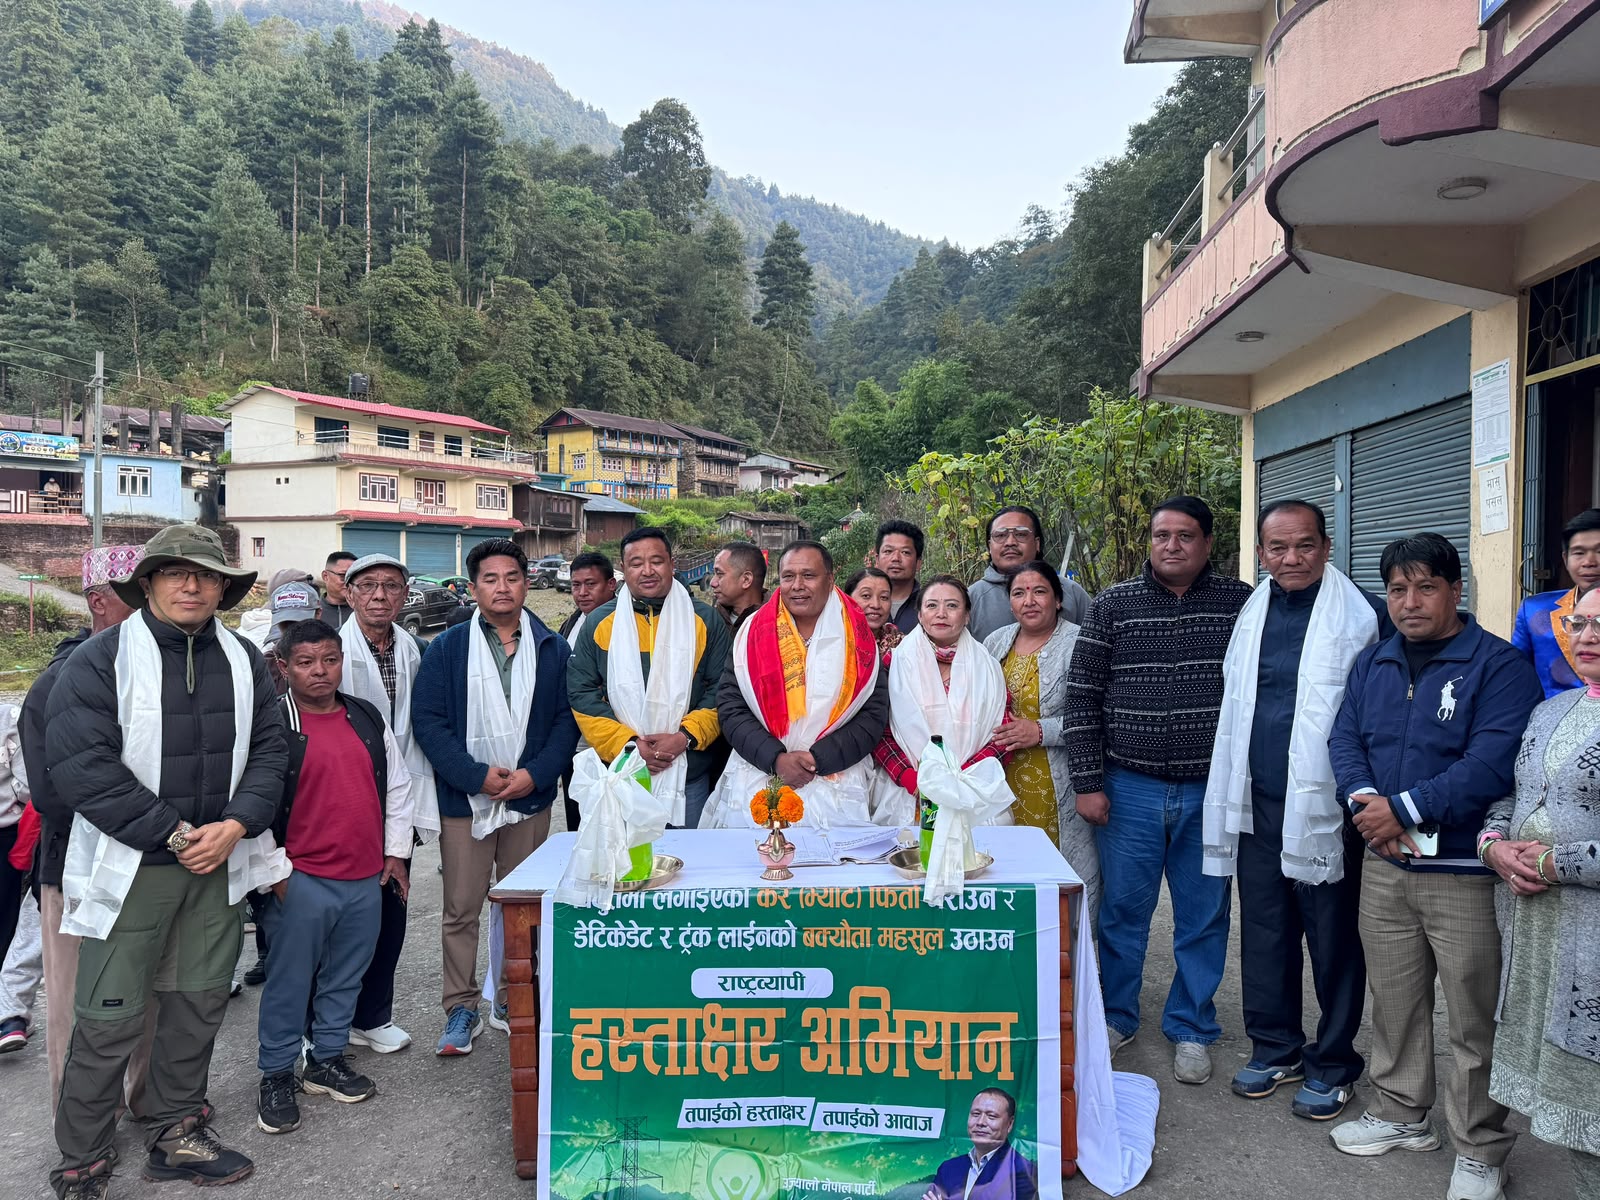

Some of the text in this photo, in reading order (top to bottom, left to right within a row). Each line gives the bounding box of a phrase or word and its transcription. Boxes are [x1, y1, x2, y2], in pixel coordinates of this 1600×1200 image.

[1002, 889, 1017, 911] र
[573, 918, 1016, 956] डेटिकेडेट र ट्रंक लाईनको बक्यौता महसुल उठाउन
[717, 970, 806, 996] राष्ट्रव्यापी
[569, 985, 1019, 1082] हस्ताक्षर अभियान
[685, 1101, 807, 1124] तपाईको हस्ताक्षर
[822, 1107, 934, 1132] तपाईको आवाज
[782, 1176, 820, 1192] उज्यालो
[821, 1178, 852, 1194] नेपाल
